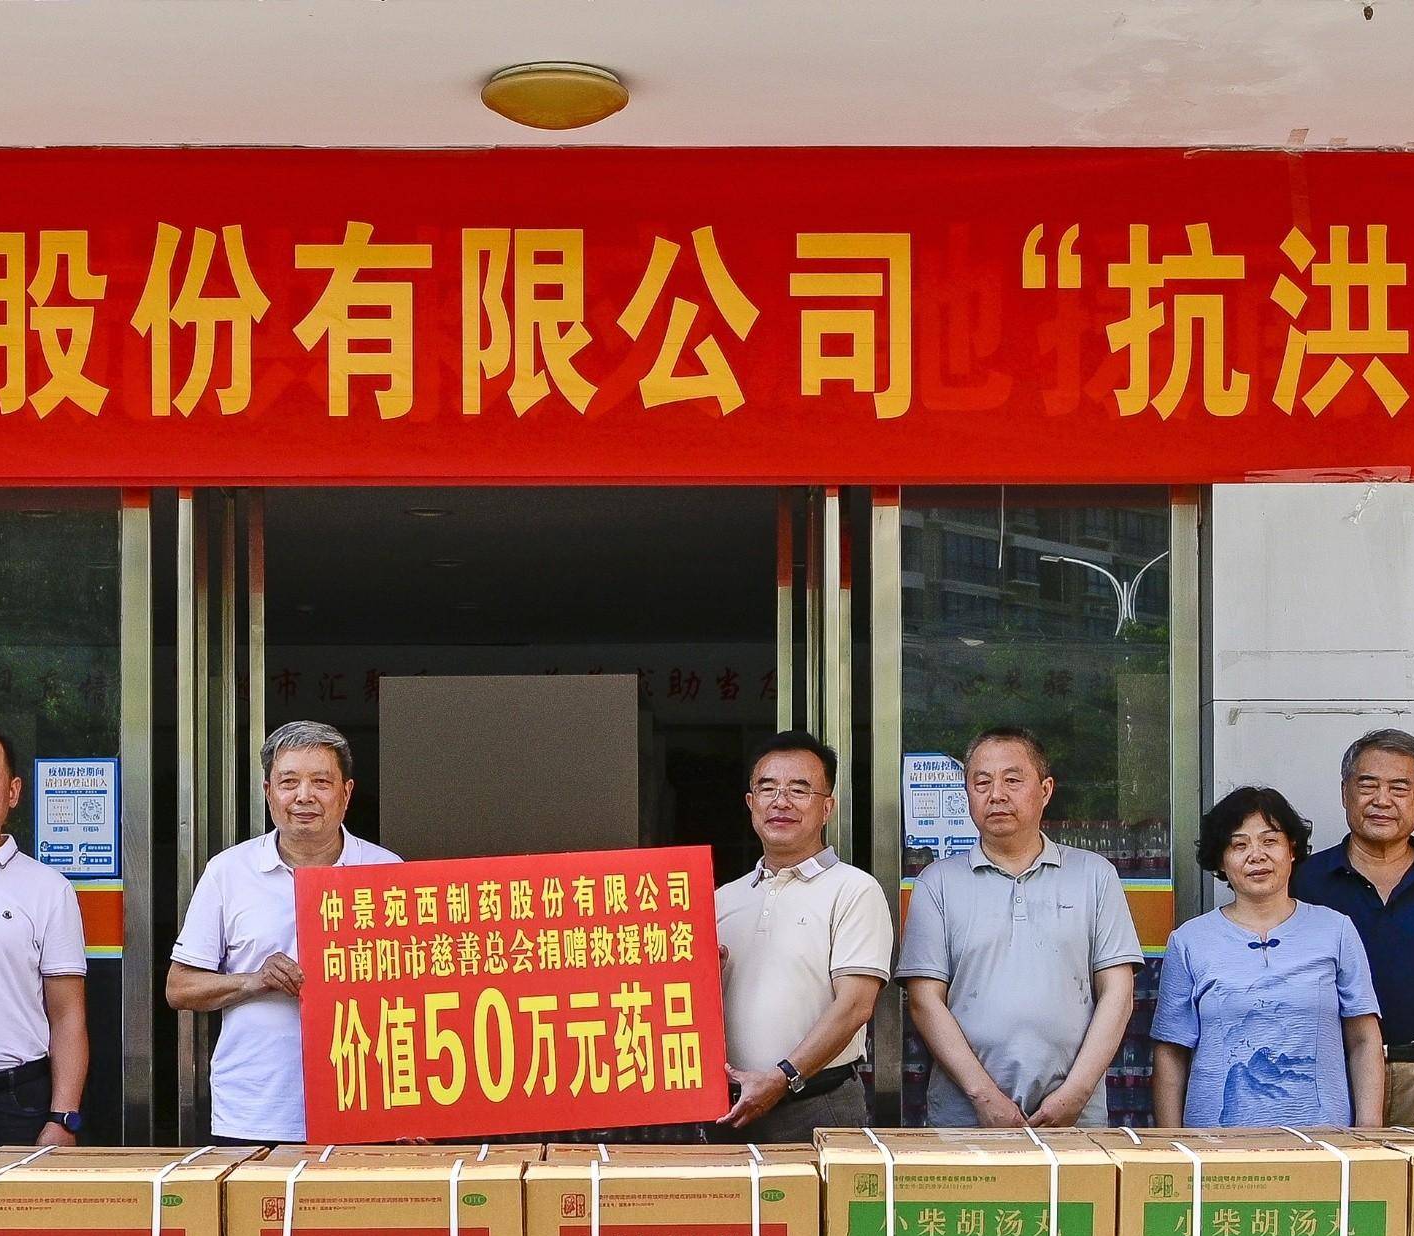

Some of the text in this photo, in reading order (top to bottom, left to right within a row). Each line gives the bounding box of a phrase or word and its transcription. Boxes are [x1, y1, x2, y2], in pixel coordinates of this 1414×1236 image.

[48, 767, 105, 777] 疫情防控期间
[320, 871, 691, 932] 仲景宛西制药股份有限公司
[322, 922, 695, 984] 向南阳市慈善总会捐赠救援物资
[329, 982, 703, 1112] 价值50万元药品
